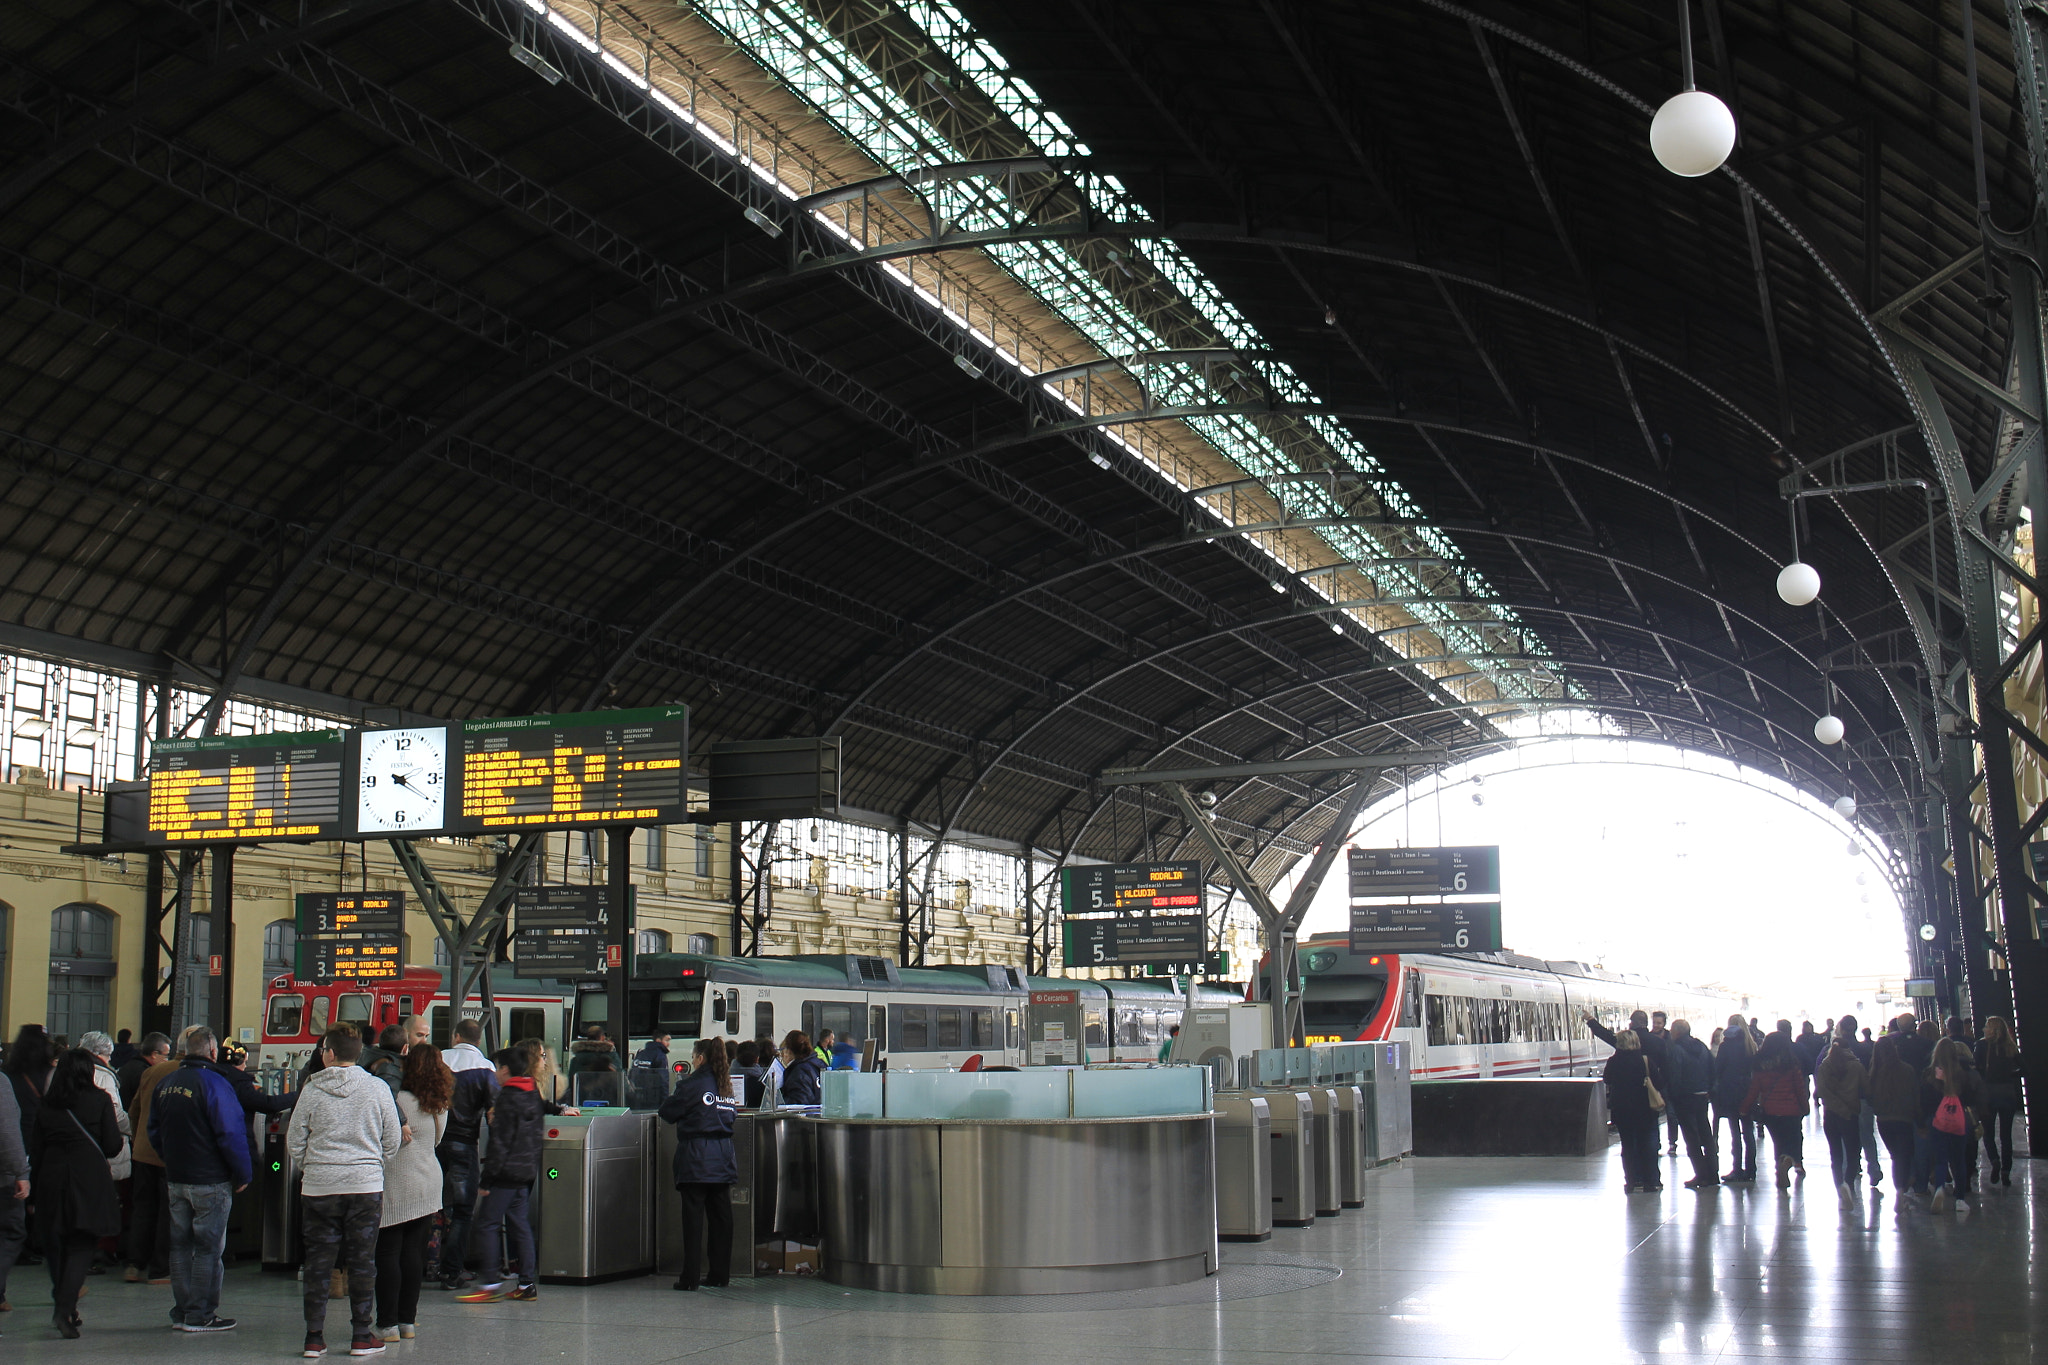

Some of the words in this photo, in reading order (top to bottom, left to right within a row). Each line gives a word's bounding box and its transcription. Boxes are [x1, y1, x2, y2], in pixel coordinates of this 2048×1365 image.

[466, 722, 492, 731] Llegadas
[496, 720, 527, 728] ARRIBADES
[395, 738, 411, 751] 12
[554, 747, 582, 756] RODALIA
[230, 766, 255, 776] RODALIA
[285, 764, 291, 773] 5
[465, 762, 484, 771] 14:32
[485, 760, 520, 770] BARCELONA
[484, 770, 508, 779] MADRID
[511, 768, 534, 777] ATOCHA
[537, 767, 552, 776] CER.
[635, 762, 645, 770] DE
[230, 775, 255, 784] RODALIA
[282, 773, 290, 781] 21
[366, 776, 376, 788] 9
[427, 772, 437, 784] 3
[484, 778, 519, 788] BARCELONA
[522, 777, 542, 786] SANTS
[555, 775, 575, 784] TALGO
[169, 788, 190, 796] GANDIA
[229, 784, 255, 792] RODALIA
[285, 782, 290, 790] 3
[553, 784, 582, 793] RODALIA
[229, 792, 254, 801] RODALIA
[284, 790, 290, 799] 2
[464, 799, 482, 807] 14:51
[553, 793, 582, 802] RODALIA
[168, 804, 189, 813] GANDIA
[228, 801, 254, 810] RODALIA
[463, 808, 482, 816] 14:55
[484, 806, 507, 815] GANDIA
[553, 802, 581, 811] RODALIA
[395, 810, 405, 822] 6
[518, 816, 523, 824] A
[548, 814, 557, 823] DE
[559, 813, 572, 822] LOS
[576, 812, 599, 821] TRENES
[602, 811, 611, 820] DE
[613, 810, 634, 819] LARGA
[637, 809, 658, 818] DISTA
[167, 821, 191, 830] ALACANT
[229, 818, 246, 827] TALGO
[239, 828, 272, 838] DISCULPEN
[273, 828, 286, 837] LAS
[287, 826, 320, 836] MOLESTIAS
[1150, 872, 1182, 881] RODALIA
[1454, 872, 1467, 891] 6
[1091, 890, 1102, 908] 5
[1116, 890, 1120, 898] L
[1124, 889, 1156, 897] ALCUDIA
[363, 900, 388, 908] RODALIA
[1116, 899, 1121, 907] A
[1152, 897, 1168, 906] CON
[598, 908, 608, 924] 4
[318, 915, 327, 930] 3
[1455, 928, 1469, 948] 6
[1093, 944, 1104, 962] 5
[317, 961, 326, 977] 3
[597, 958, 608, 974] 4
[1168, 964, 1175, 974] 4
[1183, 964, 1191, 974] A
[1198, 963, 1205, 974] 5
[381, 994, 395, 1003] 115M
[758, 989, 770, 998] 251M
